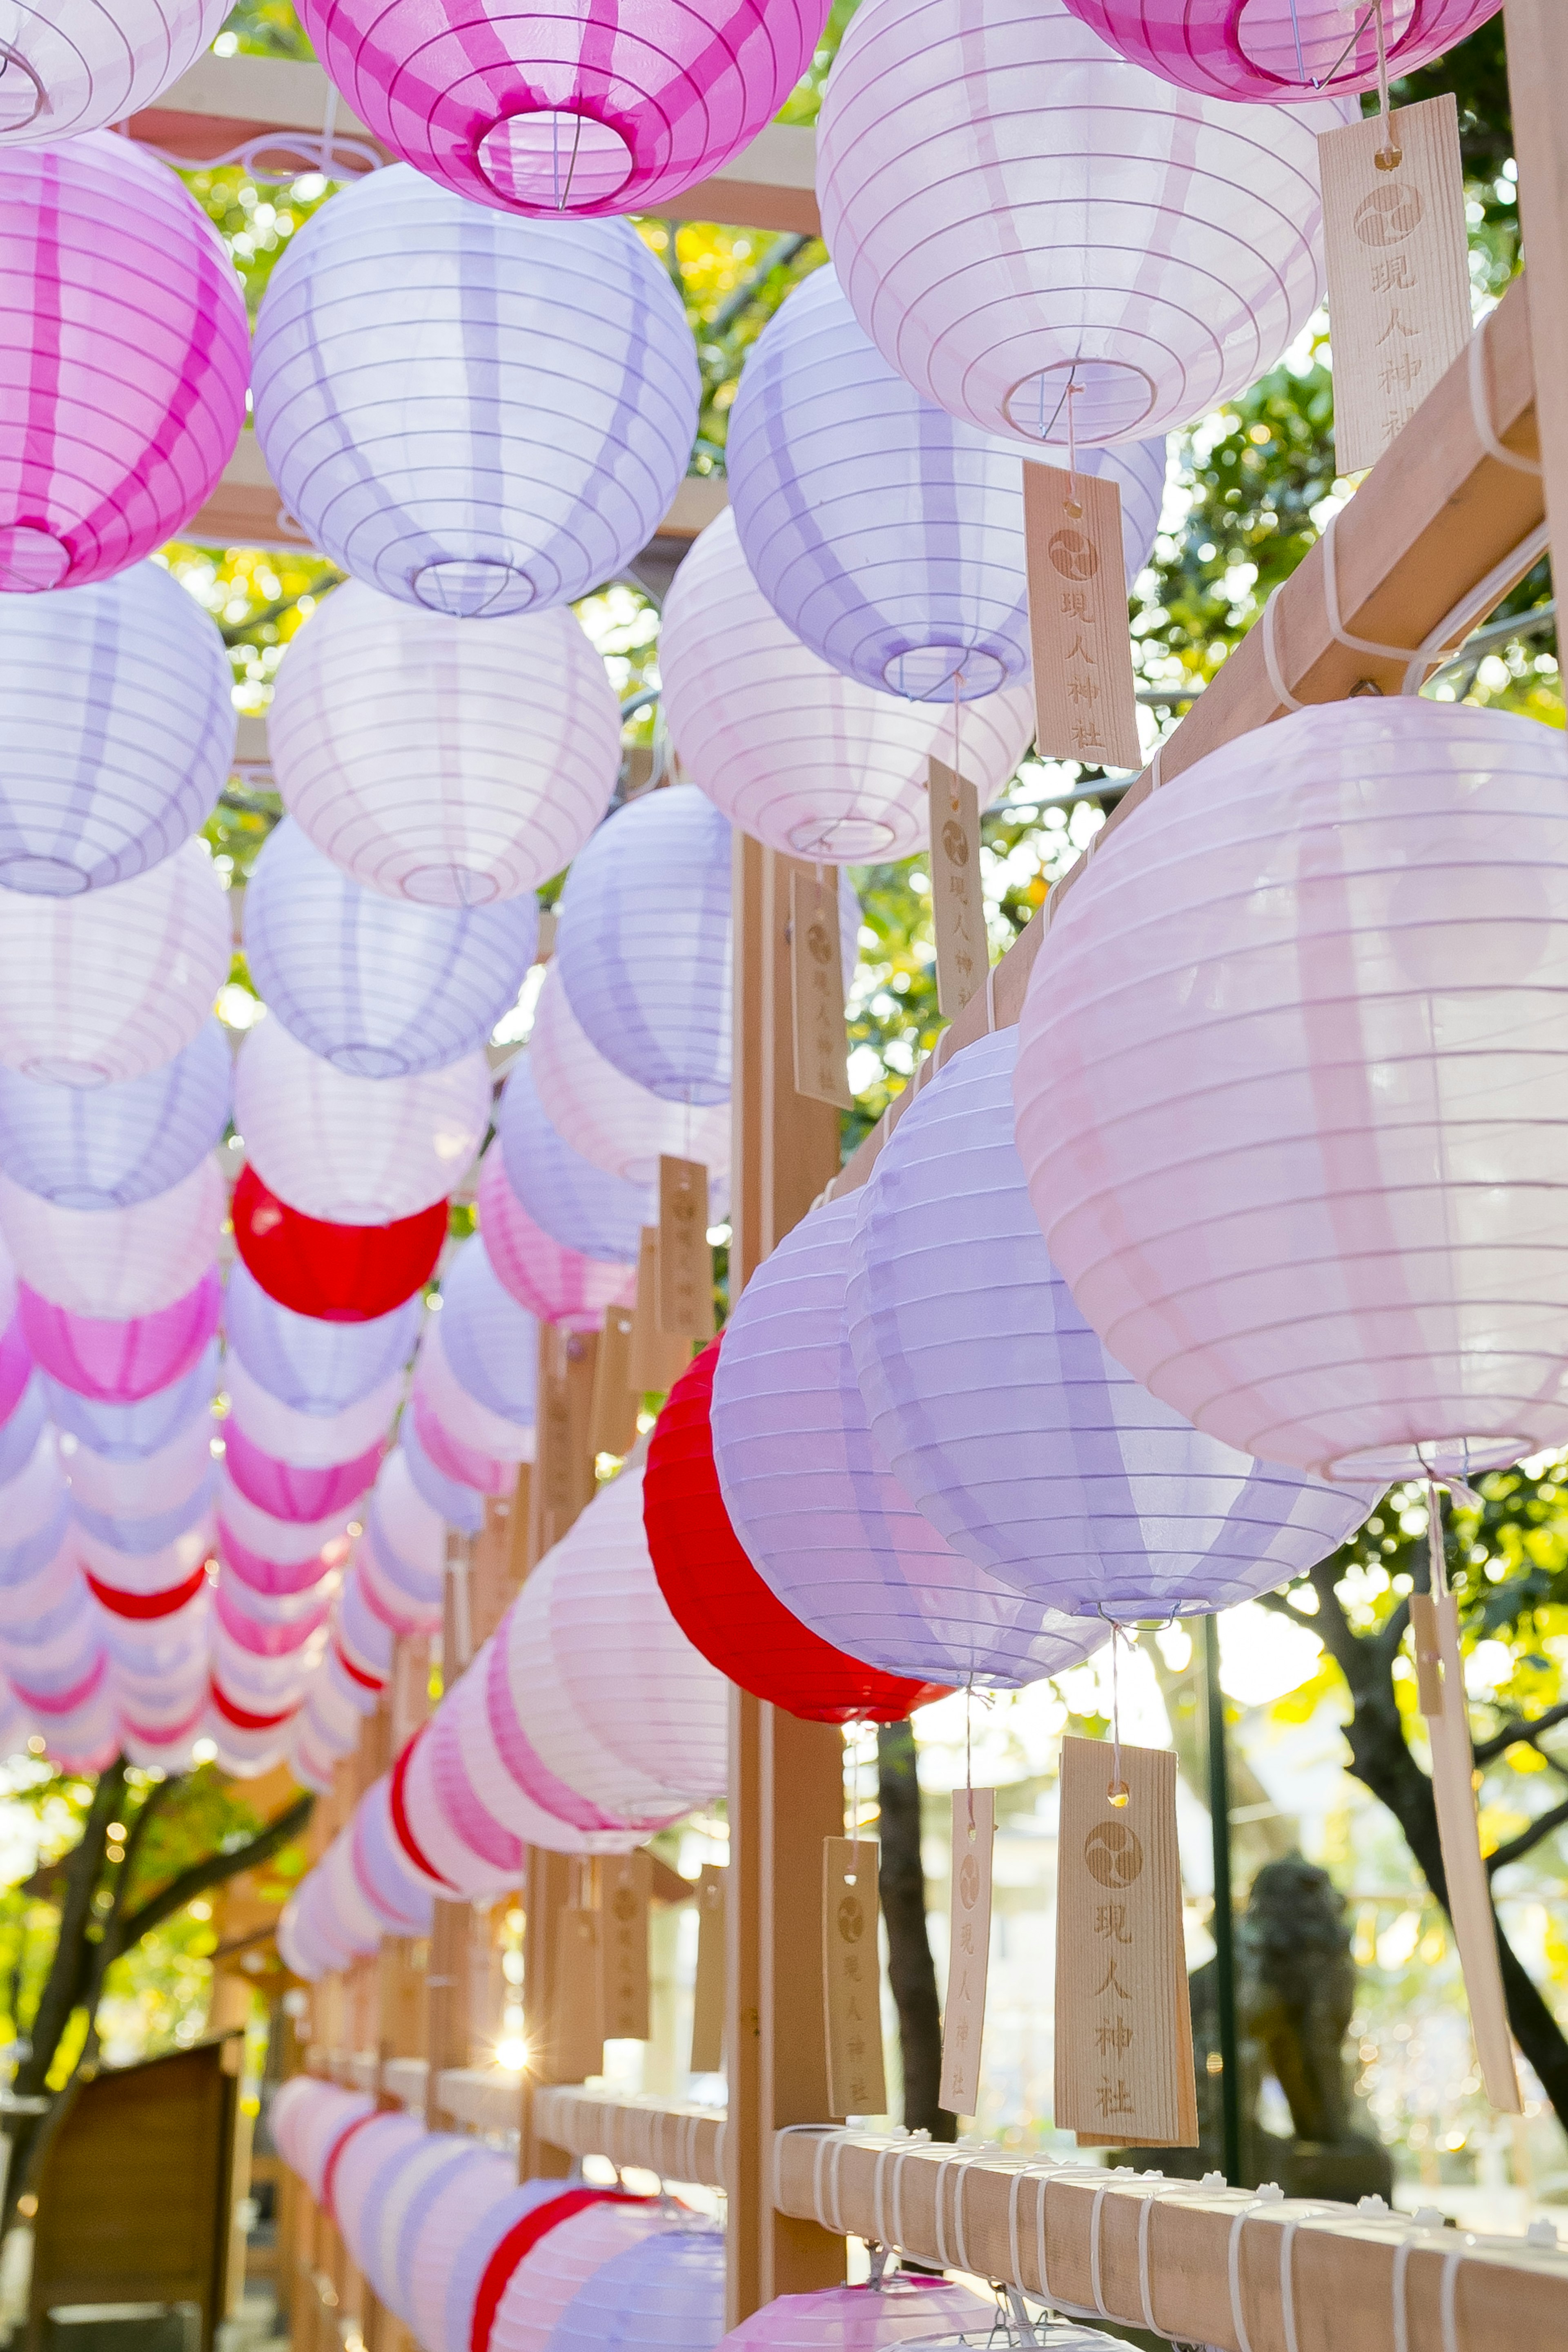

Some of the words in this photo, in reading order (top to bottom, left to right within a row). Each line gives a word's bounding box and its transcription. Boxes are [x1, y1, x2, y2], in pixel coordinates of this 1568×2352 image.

[1060, 591, 1106, 750] 現人神社
[1093, 1902, 1138, 2120] 現人神社
